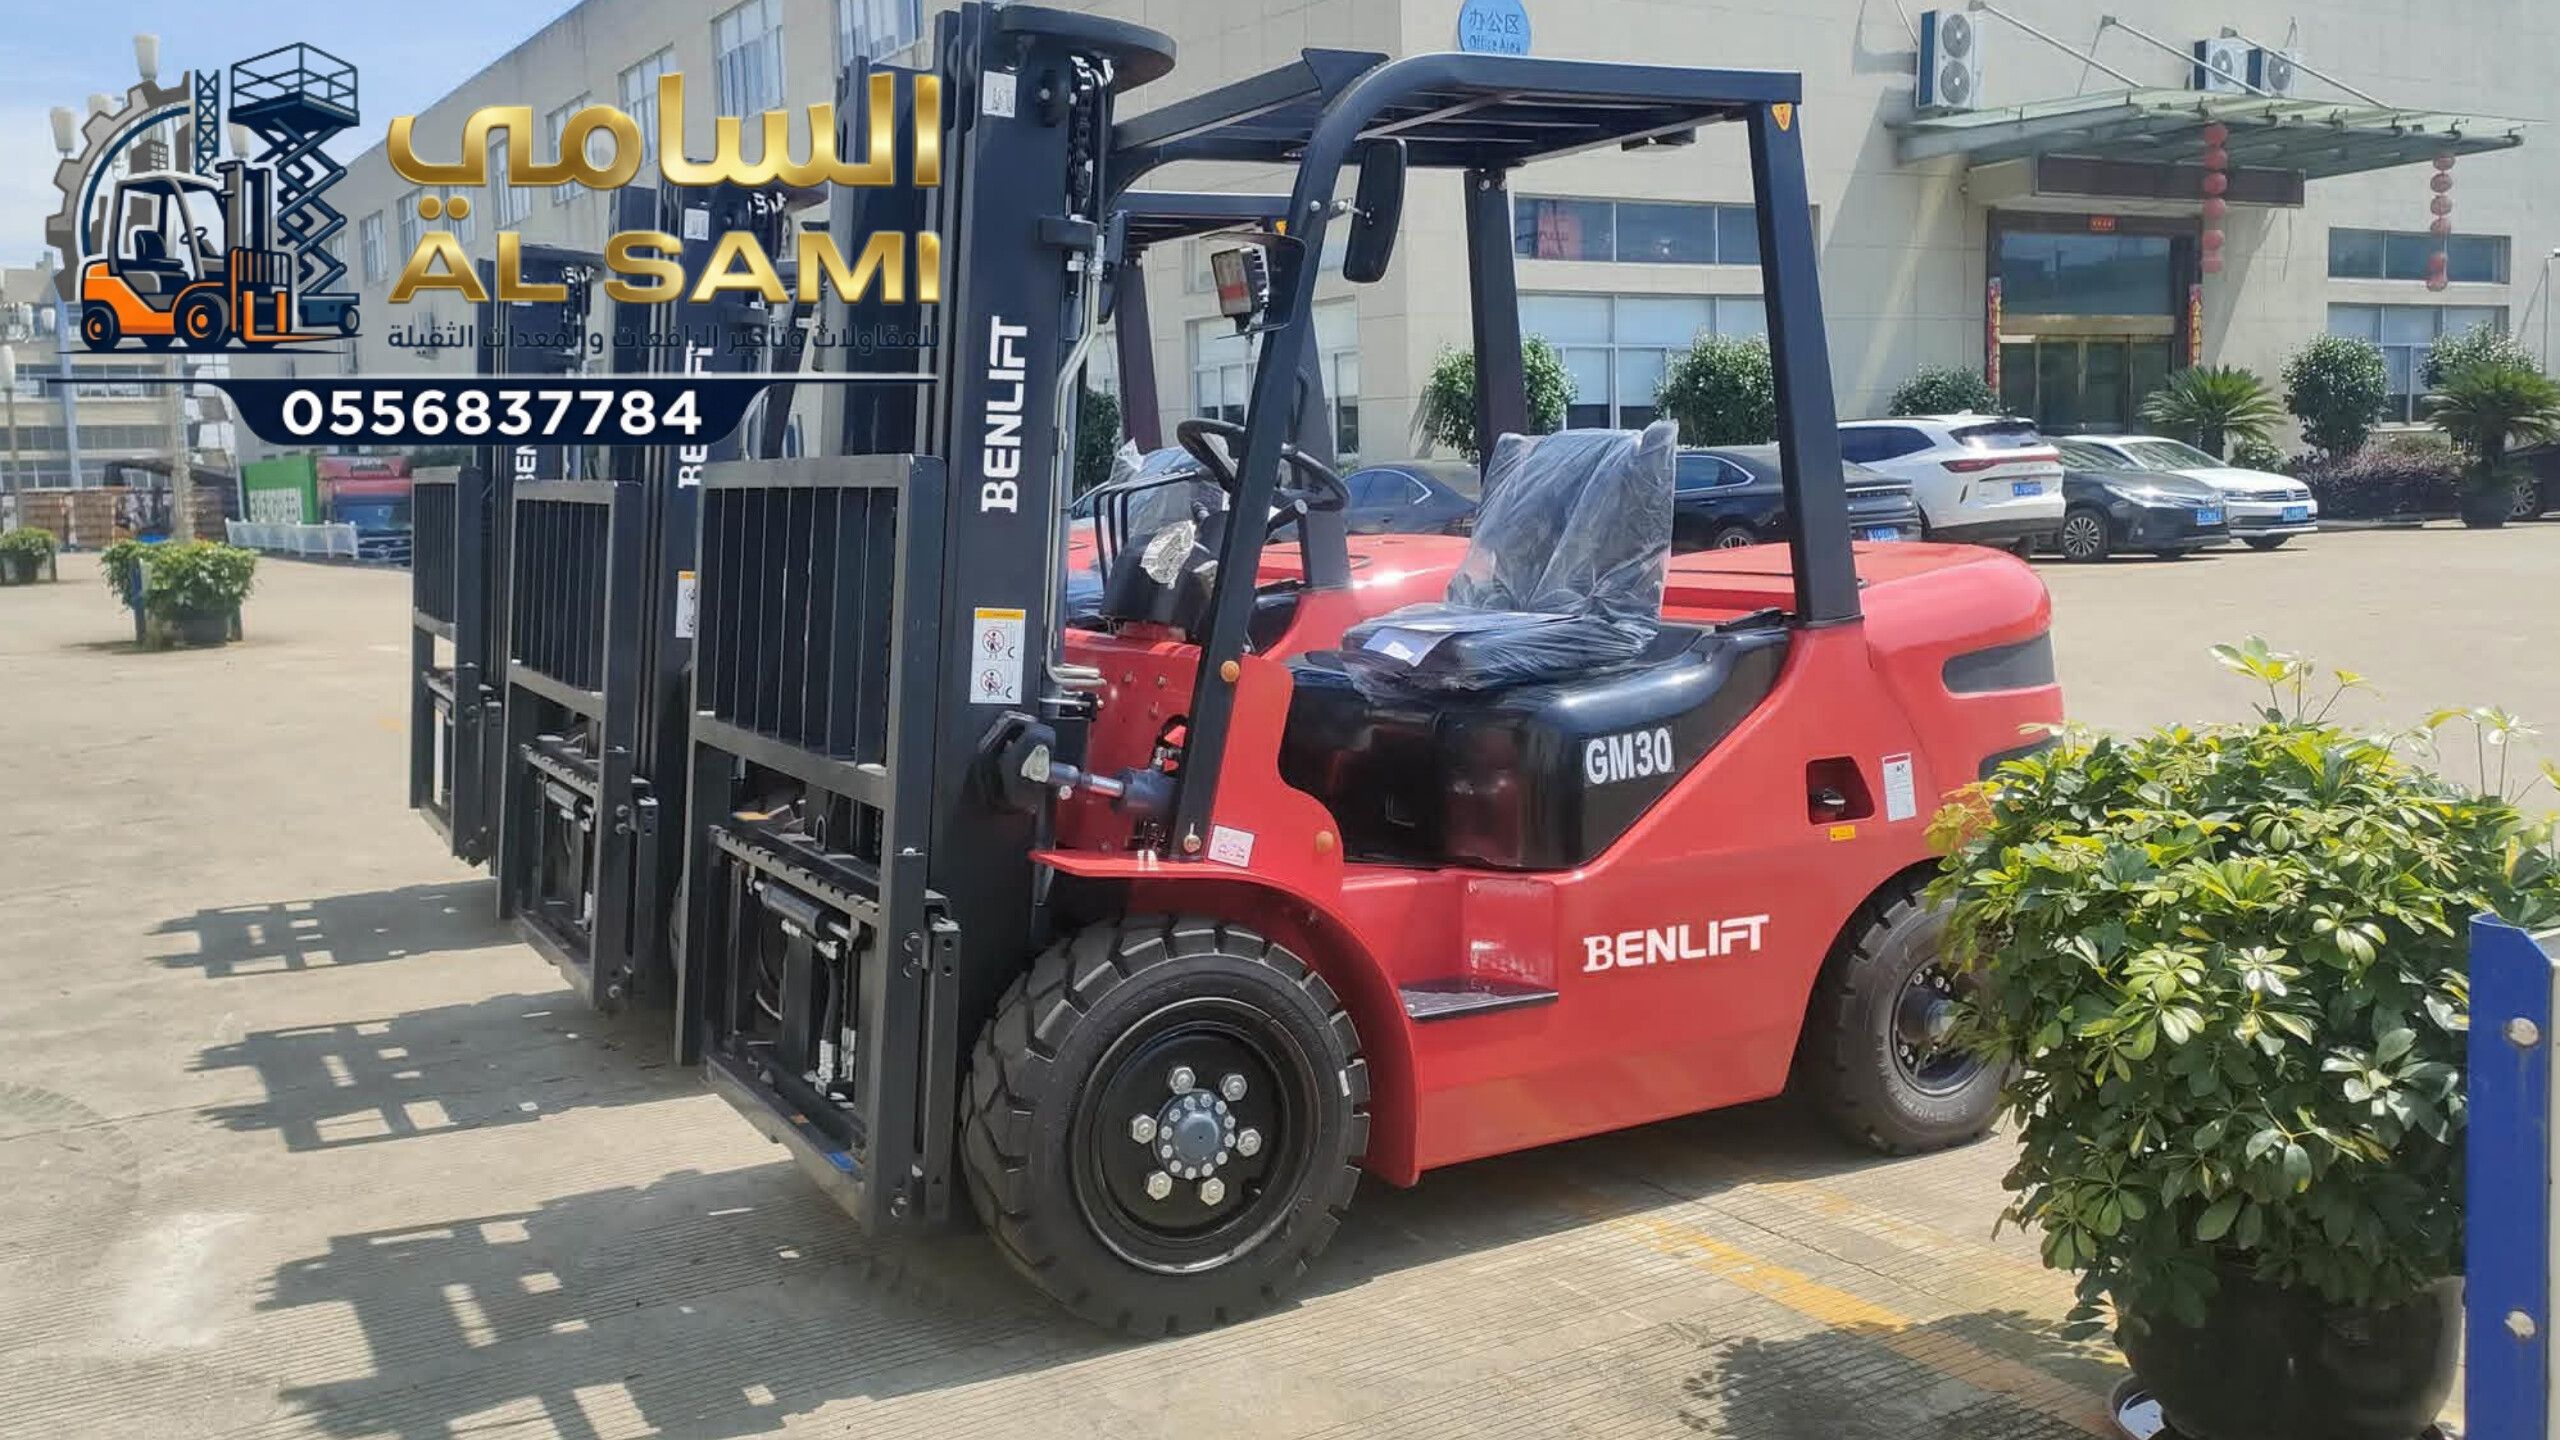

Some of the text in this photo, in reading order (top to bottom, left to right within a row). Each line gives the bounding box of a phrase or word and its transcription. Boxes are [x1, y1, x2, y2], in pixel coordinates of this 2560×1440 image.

[1469, 9, 1520, 35] 办公区
[981, 315, 1028, 513] BENLIFT
[1585, 727, 1673, 784] GM30
[1582, 914, 1769, 974] BENLIFT
